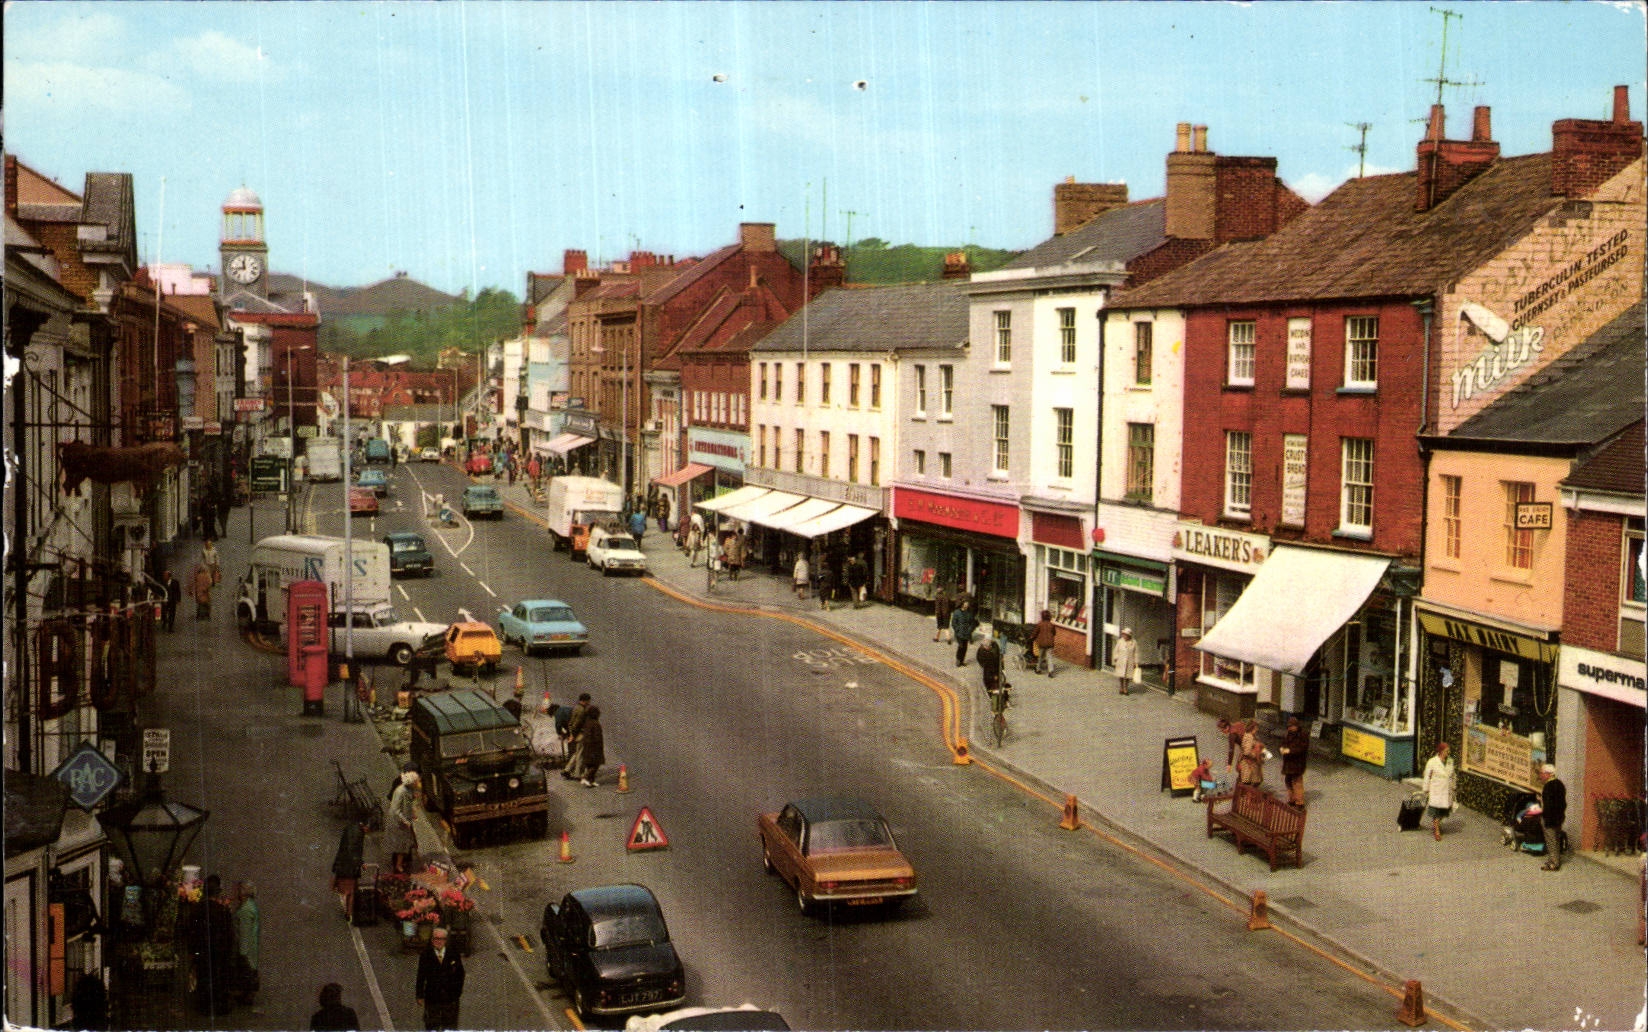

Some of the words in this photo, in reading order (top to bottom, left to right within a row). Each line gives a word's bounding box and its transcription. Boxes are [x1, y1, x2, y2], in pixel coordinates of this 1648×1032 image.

[1513, 260, 1582, 314] TUBERCULIN
[1586, 228, 1628, 263] TESTED
[1512, 288, 1559, 331] GUERNSEY
[1568, 245, 1628, 294] PASTEURISED
[1519, 514, 1548, 525] CAFE
[1185, 529, 1251, 563] LEAKER'S
[1476, 628, 1520, 655] DAIRY
[1578, 662, 1646, 690] superma
[70, 762, 105, 793] RAC
